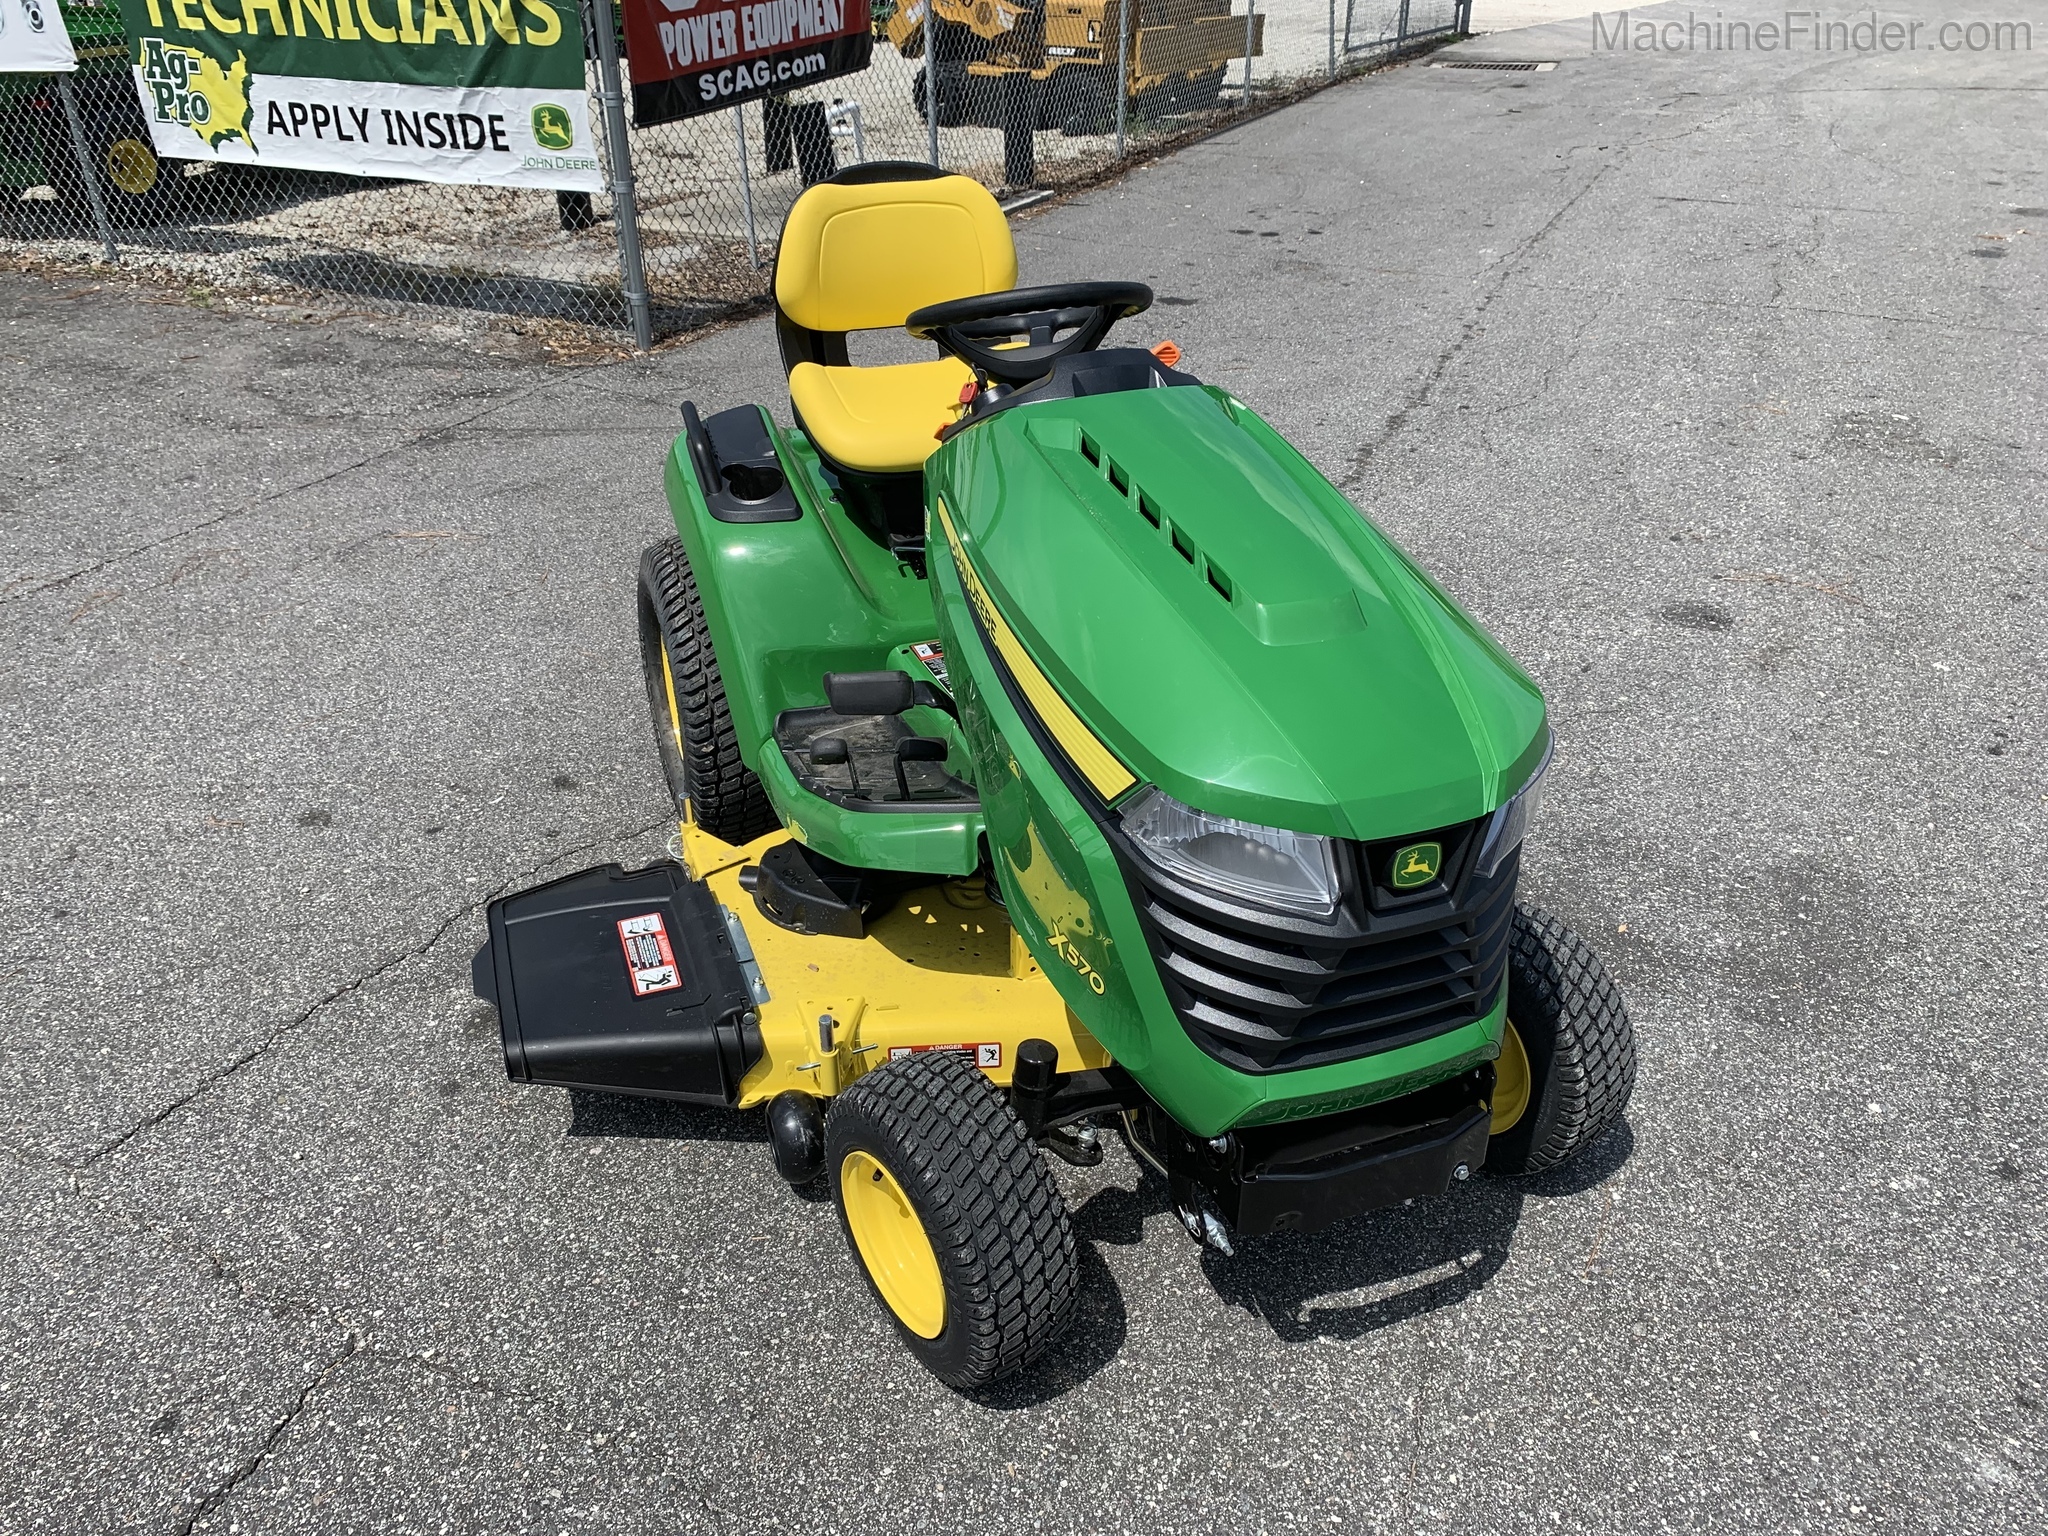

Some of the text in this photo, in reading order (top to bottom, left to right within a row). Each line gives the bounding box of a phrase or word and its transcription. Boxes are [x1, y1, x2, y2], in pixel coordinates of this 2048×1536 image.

[143, 37, 202, 92] Ag-
[658, 9, 739, 71] POWER
[150, 80, 212, 125] Pro
[698, 52, 827, 101] SCAG.com
[267, 100, 510, 152] APPLY INSIDE
[521, 155, 597, 171] JOHN DEERE
[968, 571, 998, 640] DEERE
[1046, 916, 1106, 996] X570
